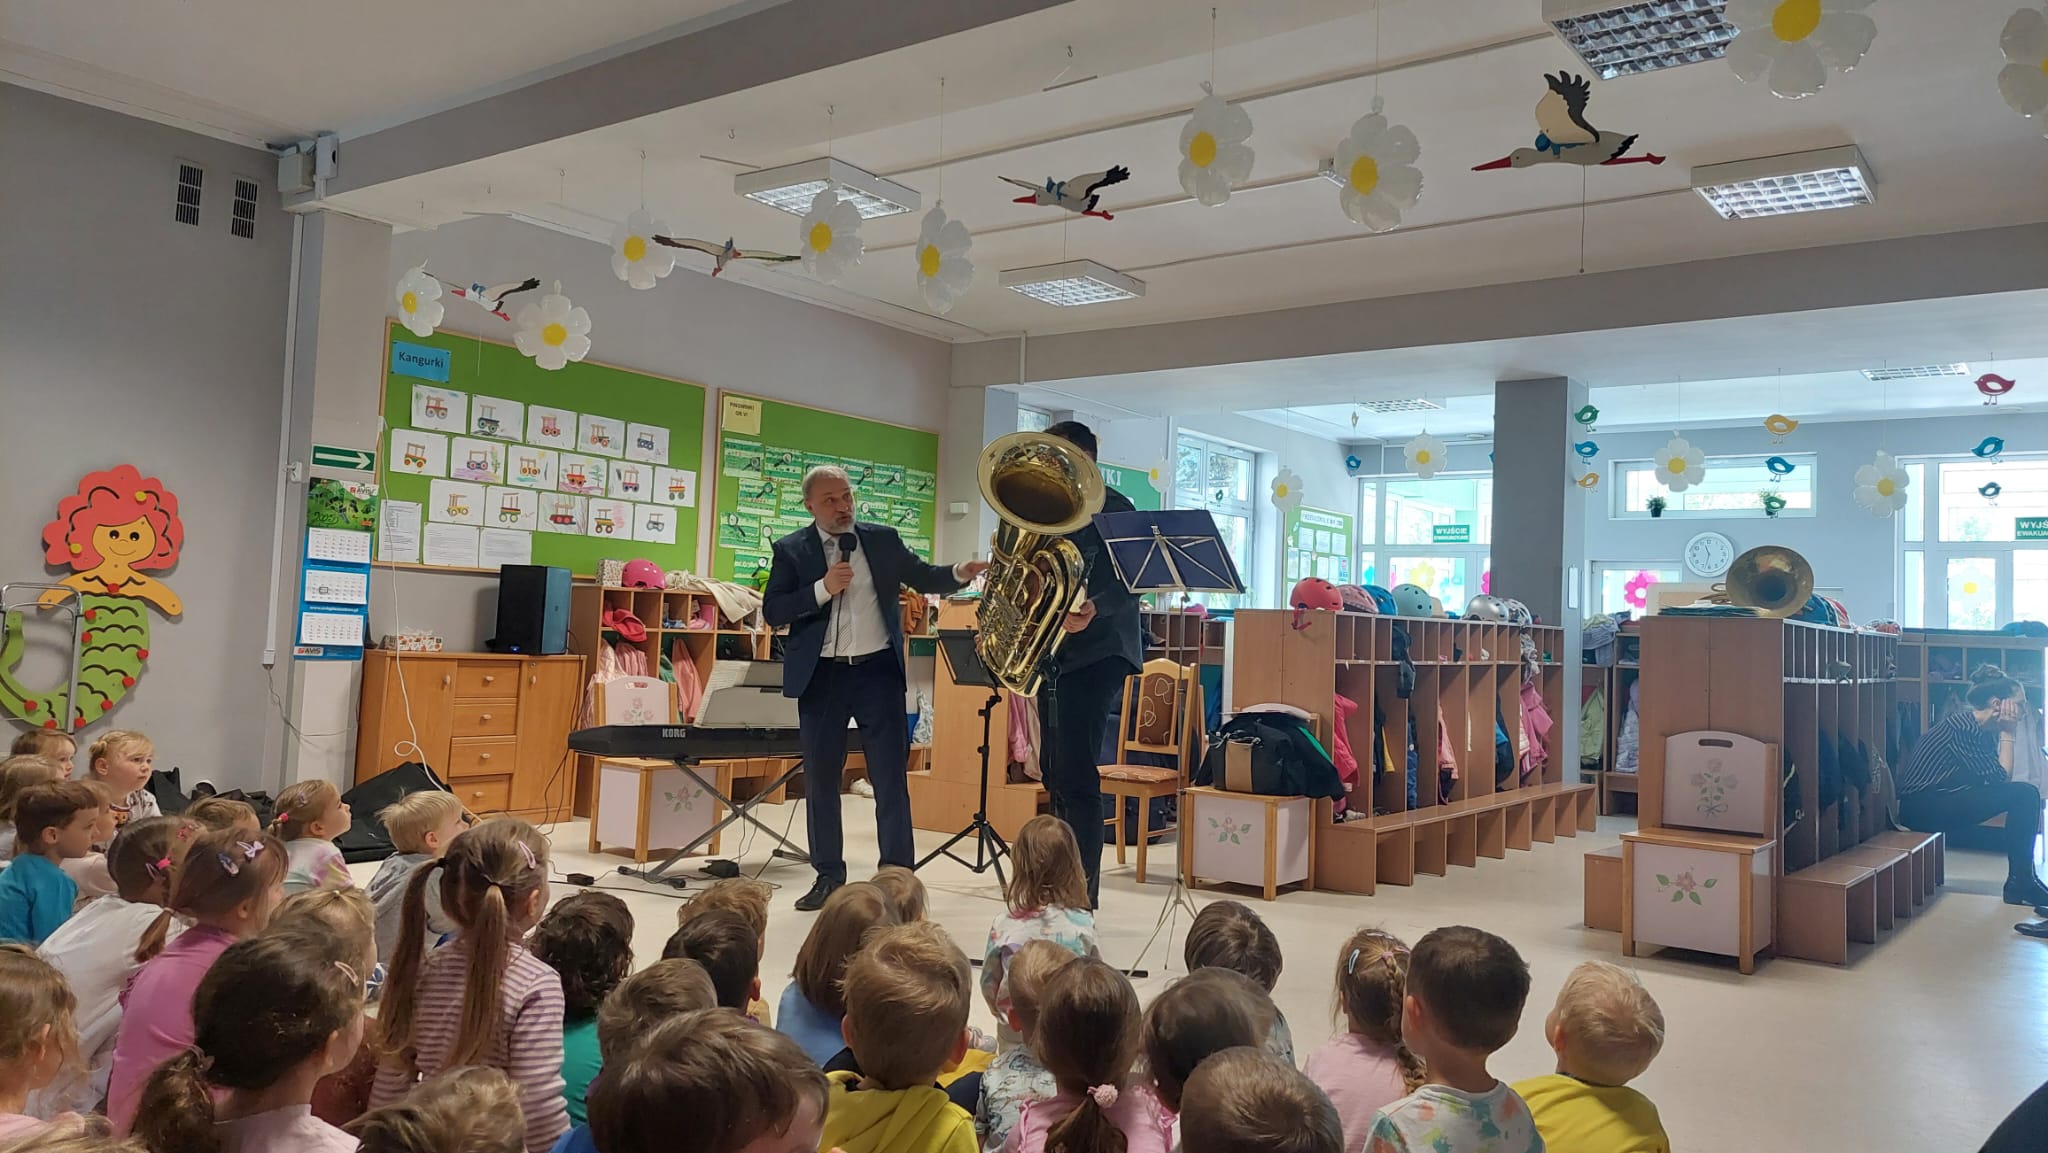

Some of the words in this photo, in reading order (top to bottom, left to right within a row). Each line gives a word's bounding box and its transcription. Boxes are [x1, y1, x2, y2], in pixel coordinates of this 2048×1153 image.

[399, 351, 444, 369] Kangurki
[1436, 526, 1467, 535] WYJŚCIE
[304, 647, 321, 655] AVIS
[662, 728, 687, 738] KORG
